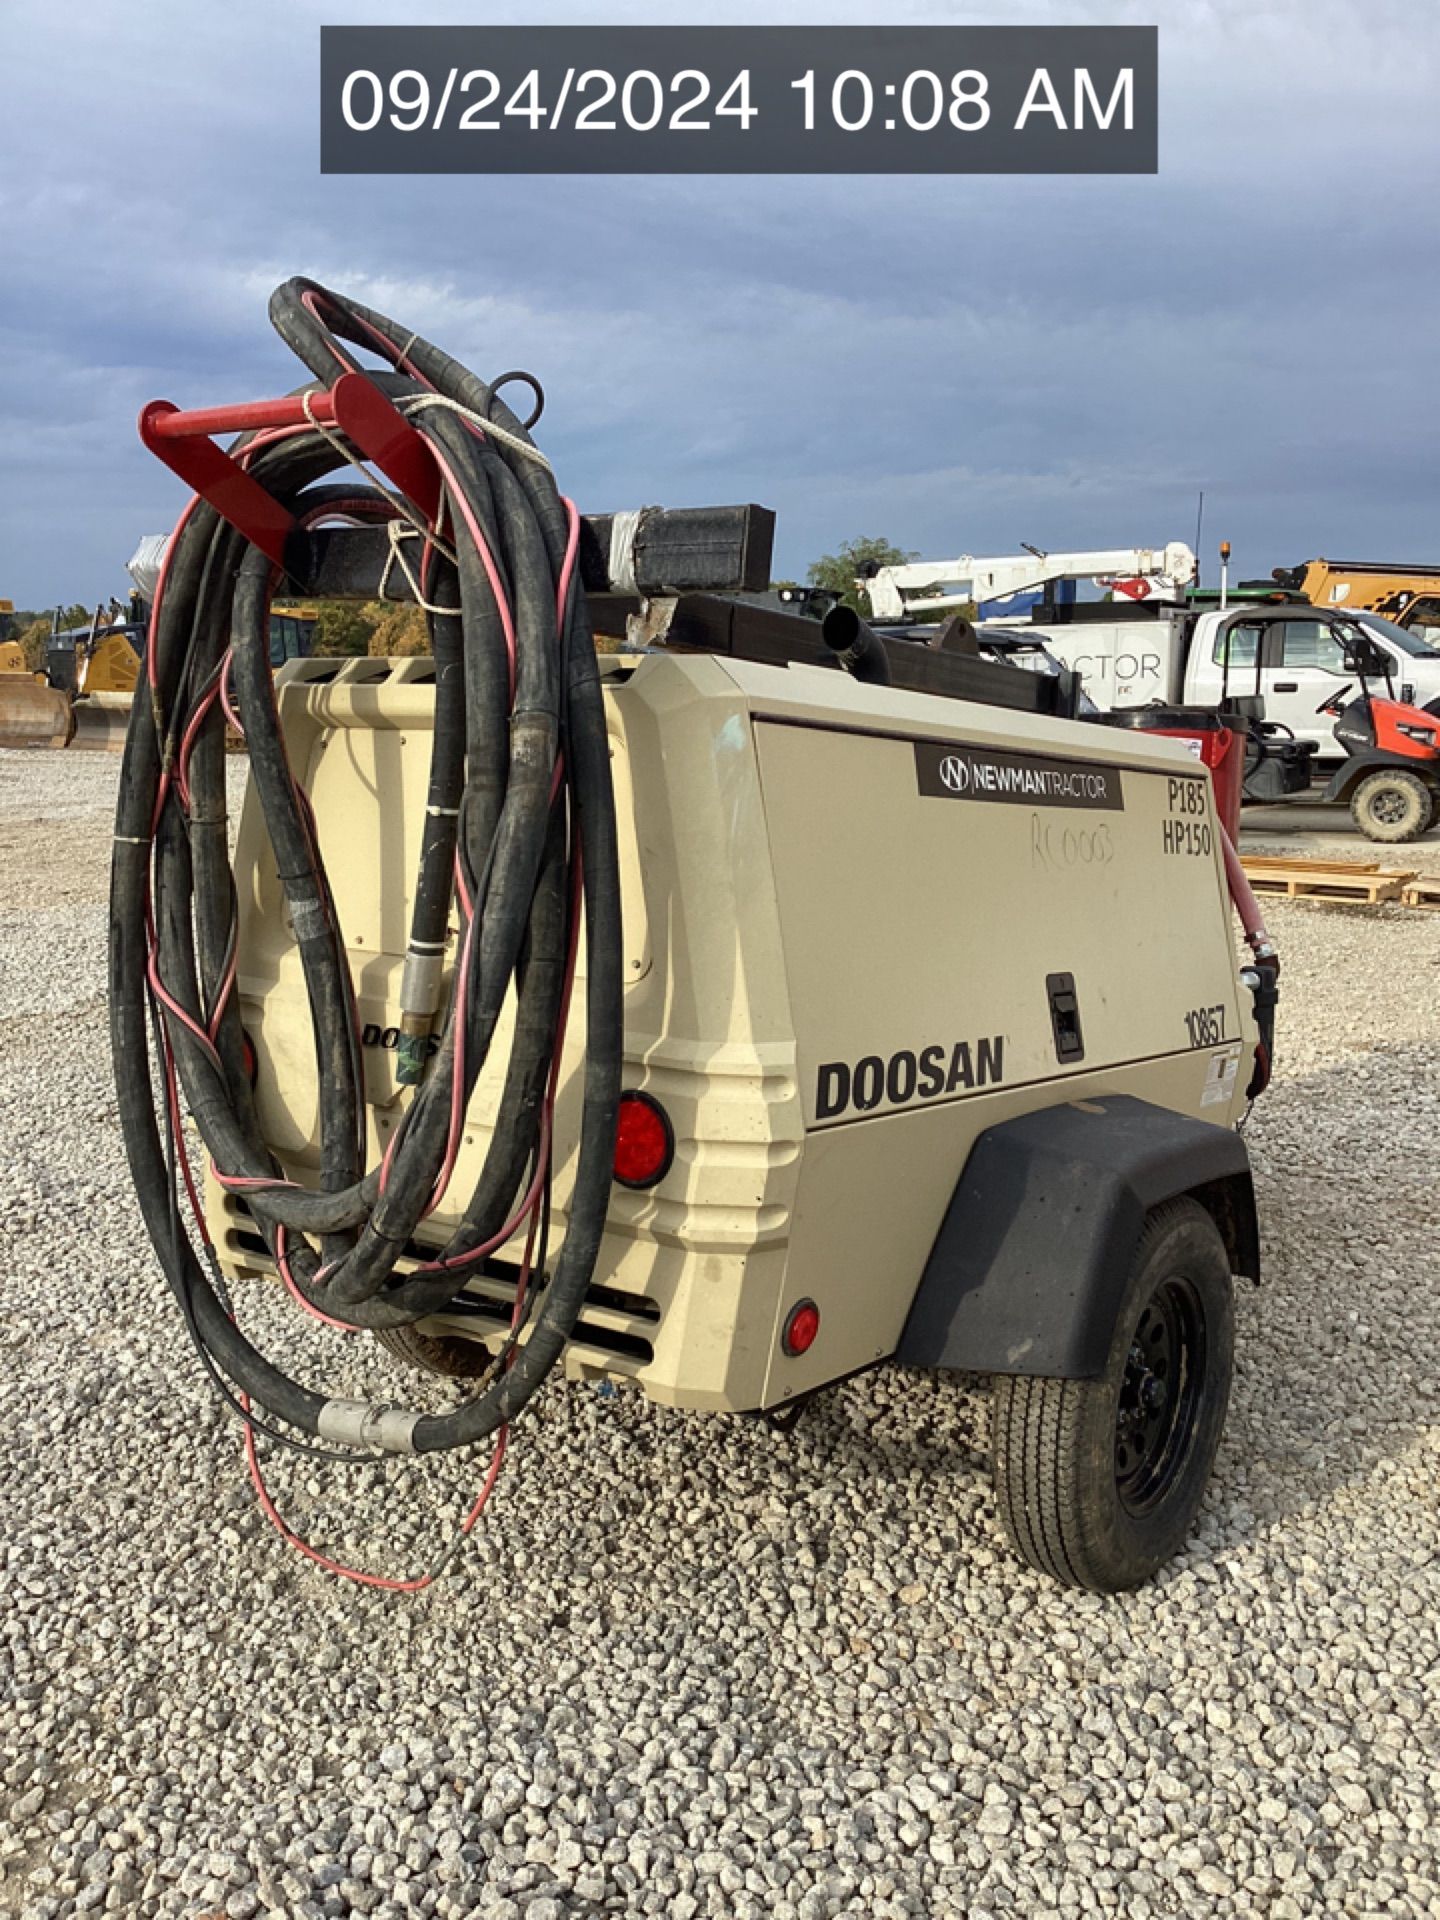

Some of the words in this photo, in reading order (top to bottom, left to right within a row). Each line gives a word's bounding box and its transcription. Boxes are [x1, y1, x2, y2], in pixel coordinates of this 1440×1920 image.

[1168, 778, 1205, 816] P185
[1163, 820, 1210, 856] HP150
[1184, 1004, 1225, 1048] 10857
[816, 1035, 1004, 1120] DOOSAN
